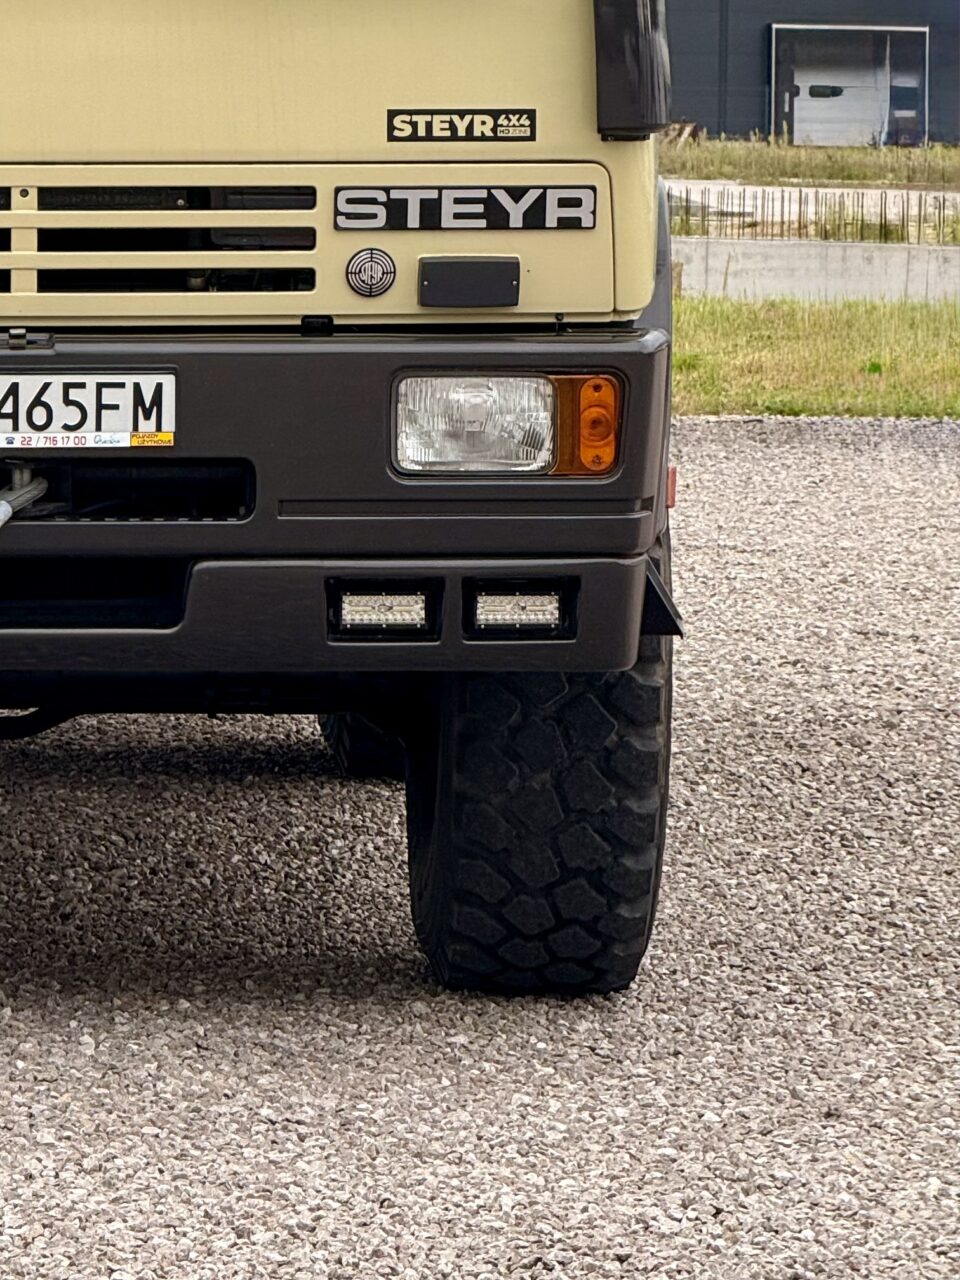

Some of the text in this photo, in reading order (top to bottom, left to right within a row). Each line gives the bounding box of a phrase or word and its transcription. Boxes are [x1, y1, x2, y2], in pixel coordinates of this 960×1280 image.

[392, 114, 494, 137] STEYR
[498, 128, 510, 136] HD
[336, 188, 595, 228] STEYR
[359, 261, 383, 285] STEYR
[20, 436, 32, 446] 22
[43, 436, 58, 446] 716
[61, 436, 70, 446] 17
[73, 436, 87, 446] 00
